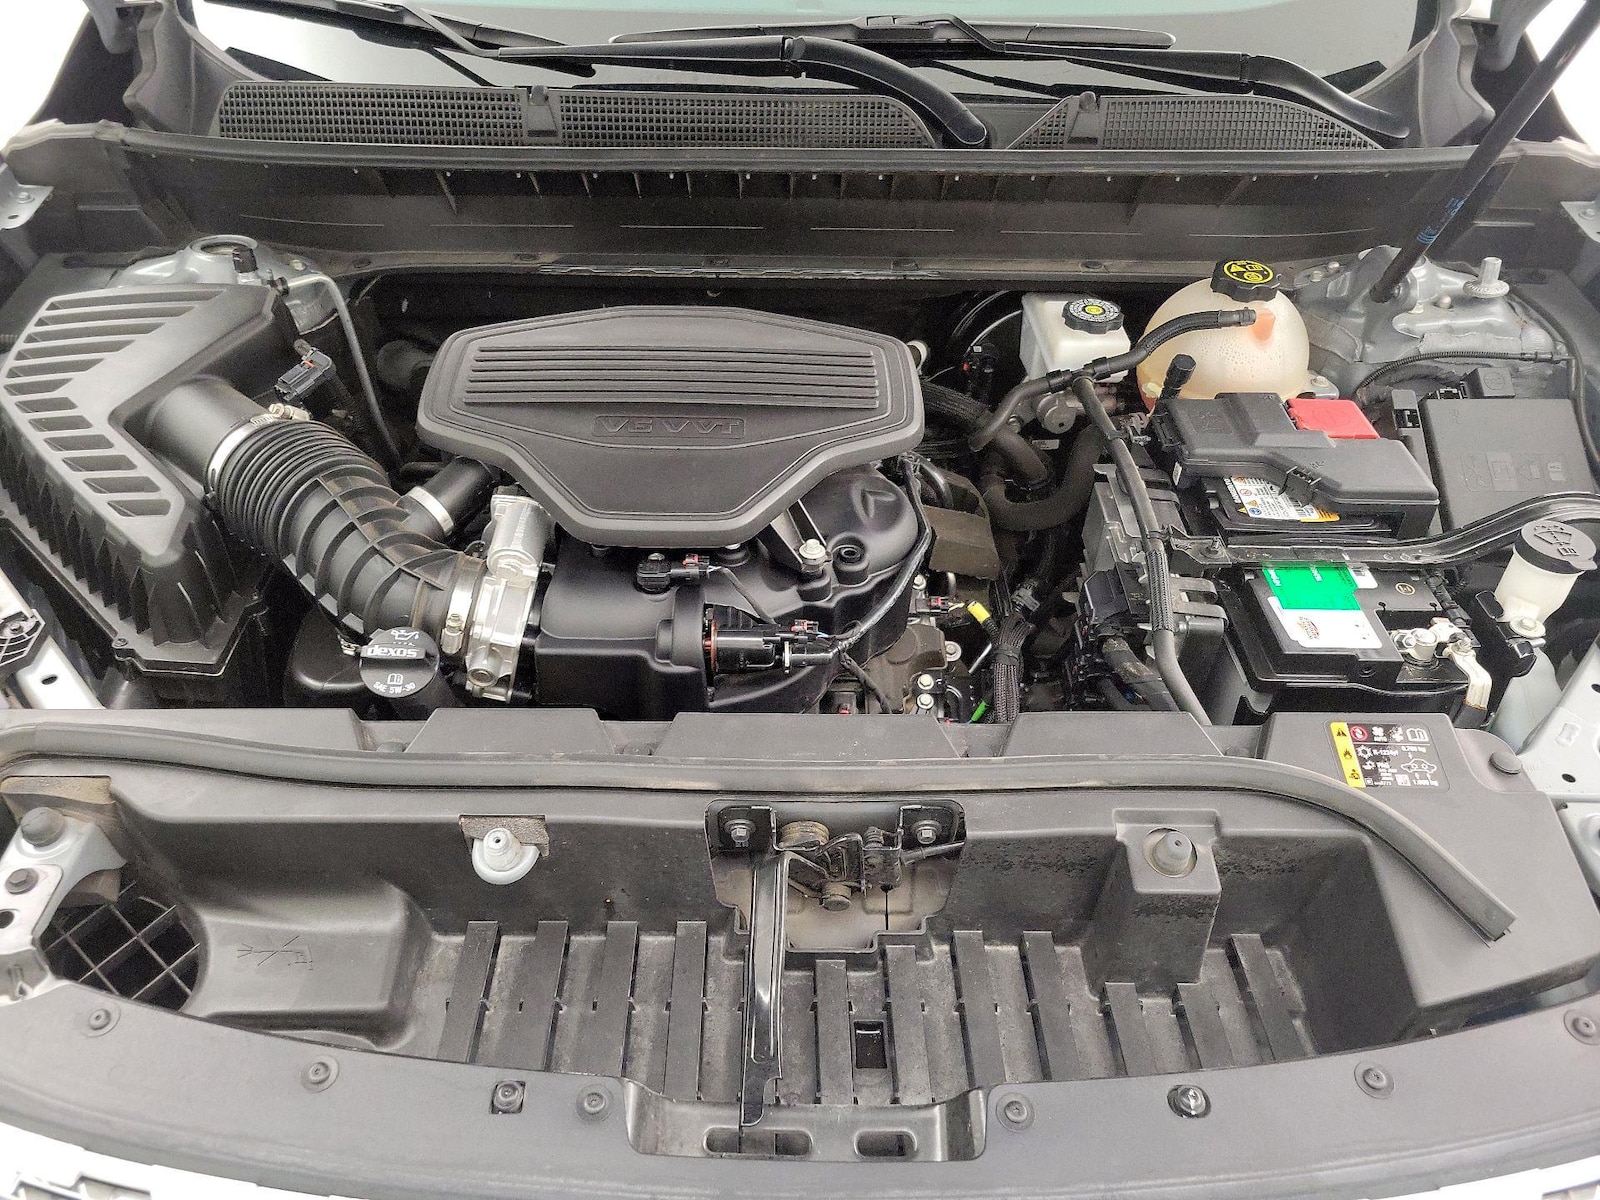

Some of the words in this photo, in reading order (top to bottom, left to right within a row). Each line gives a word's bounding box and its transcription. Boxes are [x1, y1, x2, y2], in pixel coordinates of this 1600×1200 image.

[601, 417, 653, 433] V6
[661, 418, 740, 434] VVT
[367, 645, 420, 658] dexos
[373, 681, 388, 692] SAE
[389, 682, 416, 694] 5W-30
